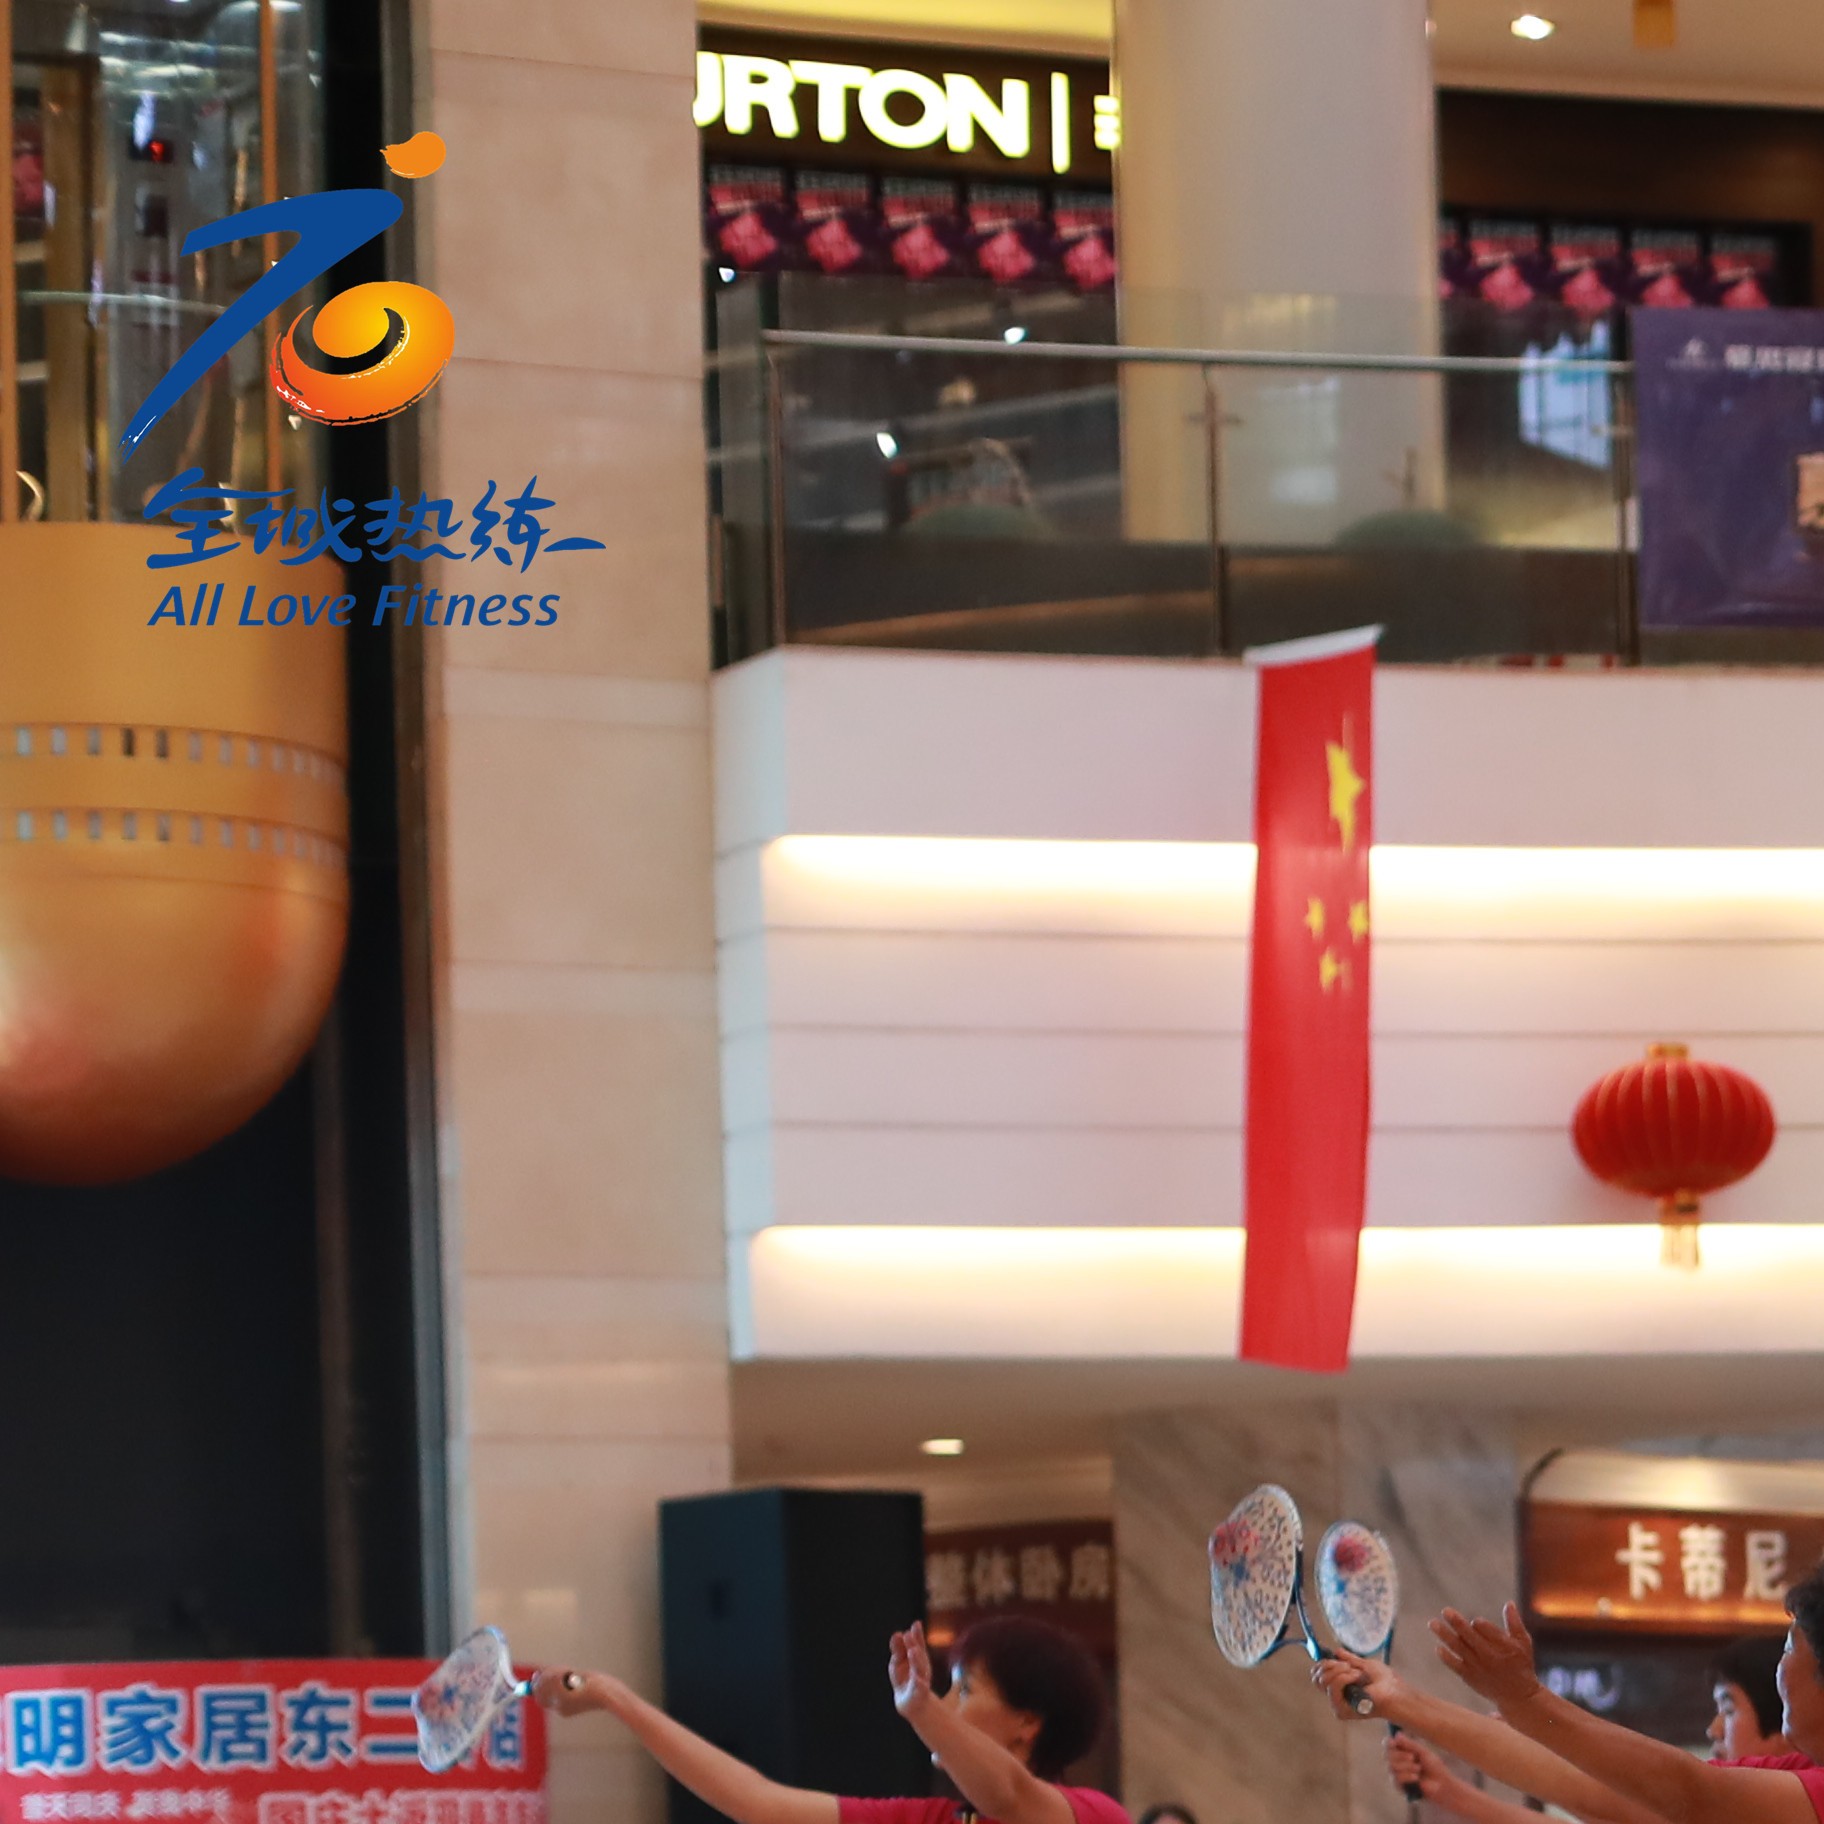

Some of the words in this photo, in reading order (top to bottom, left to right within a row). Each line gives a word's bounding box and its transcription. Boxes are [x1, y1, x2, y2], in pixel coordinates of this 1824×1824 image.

[1615, 1521, 1788, 1600] 卡蒂尼
[8, 1685, 526, 1772] 明家居东二店
